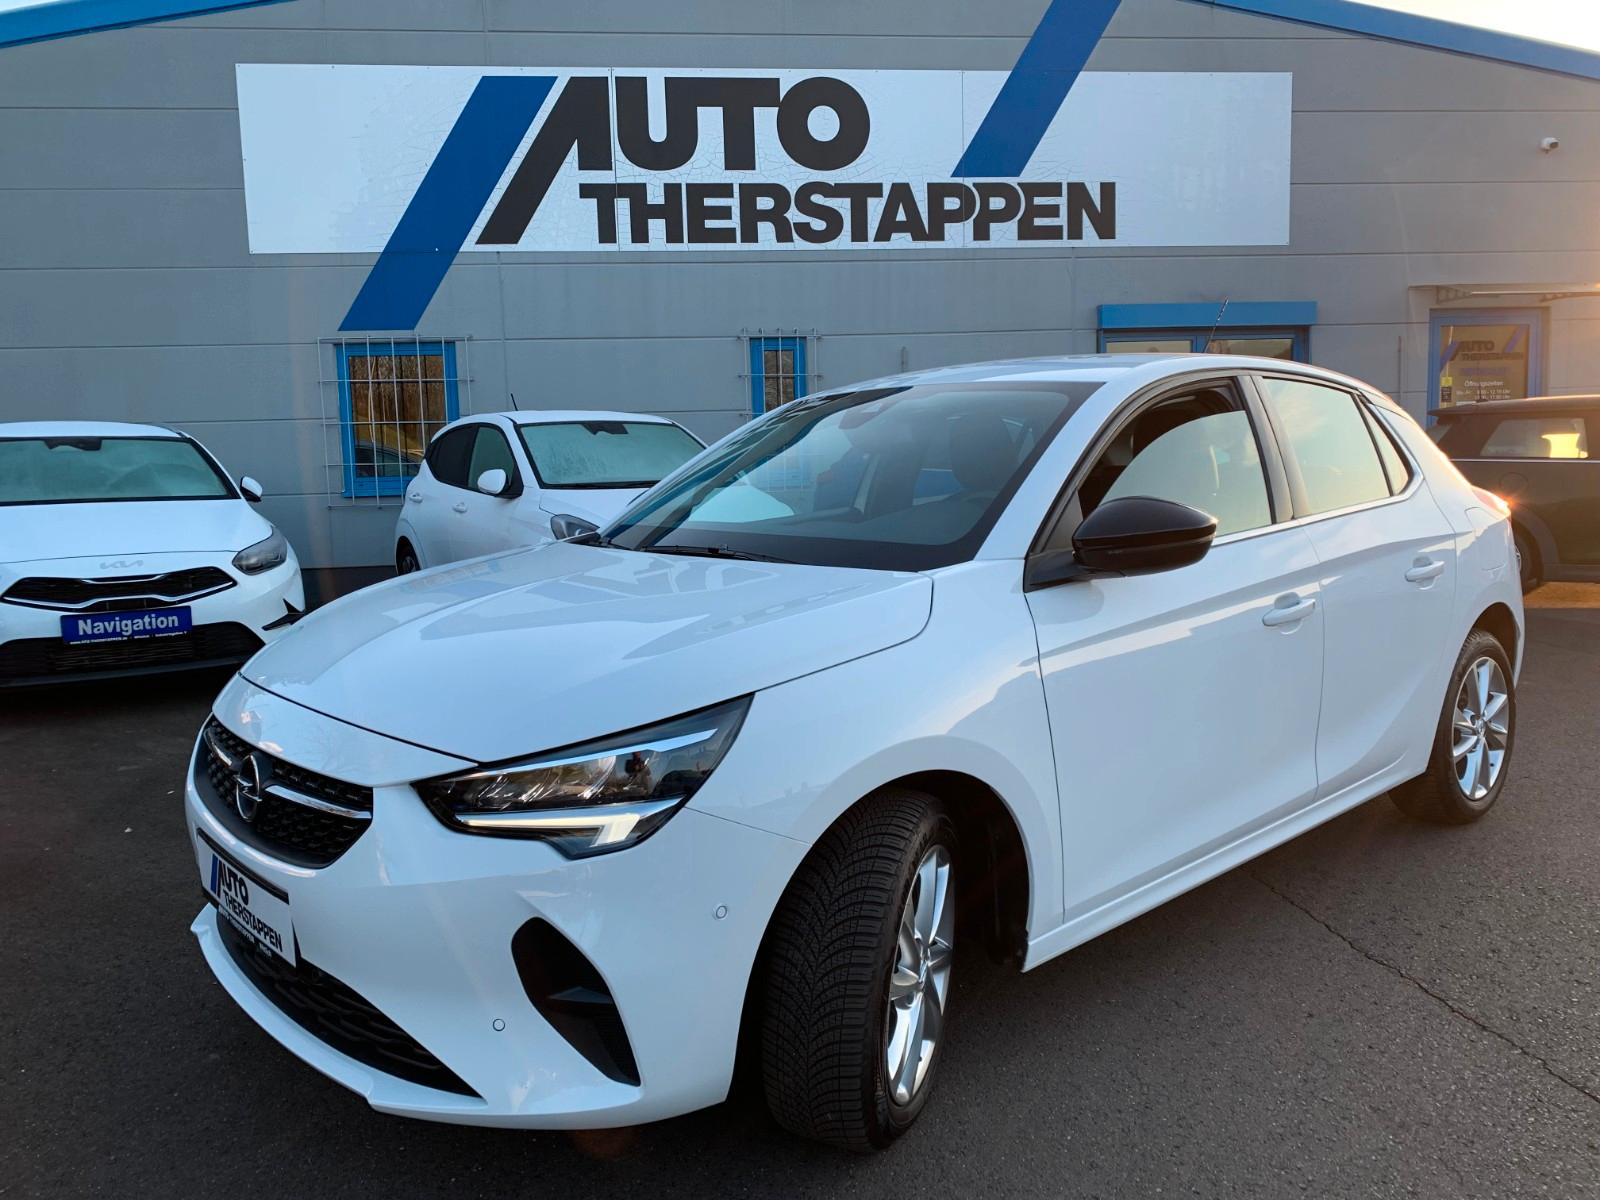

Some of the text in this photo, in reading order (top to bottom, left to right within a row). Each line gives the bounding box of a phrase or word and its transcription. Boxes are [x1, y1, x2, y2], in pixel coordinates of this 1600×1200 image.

[476, 76, 870, 244] AUTO
[579, 181, 1117, 245] THERSTAPPEN
[78, 613, 179, 636] Navigation
[217, 859, 249, 906] AUTO
[223, 889, 283, 953] THERSTAPPEN
